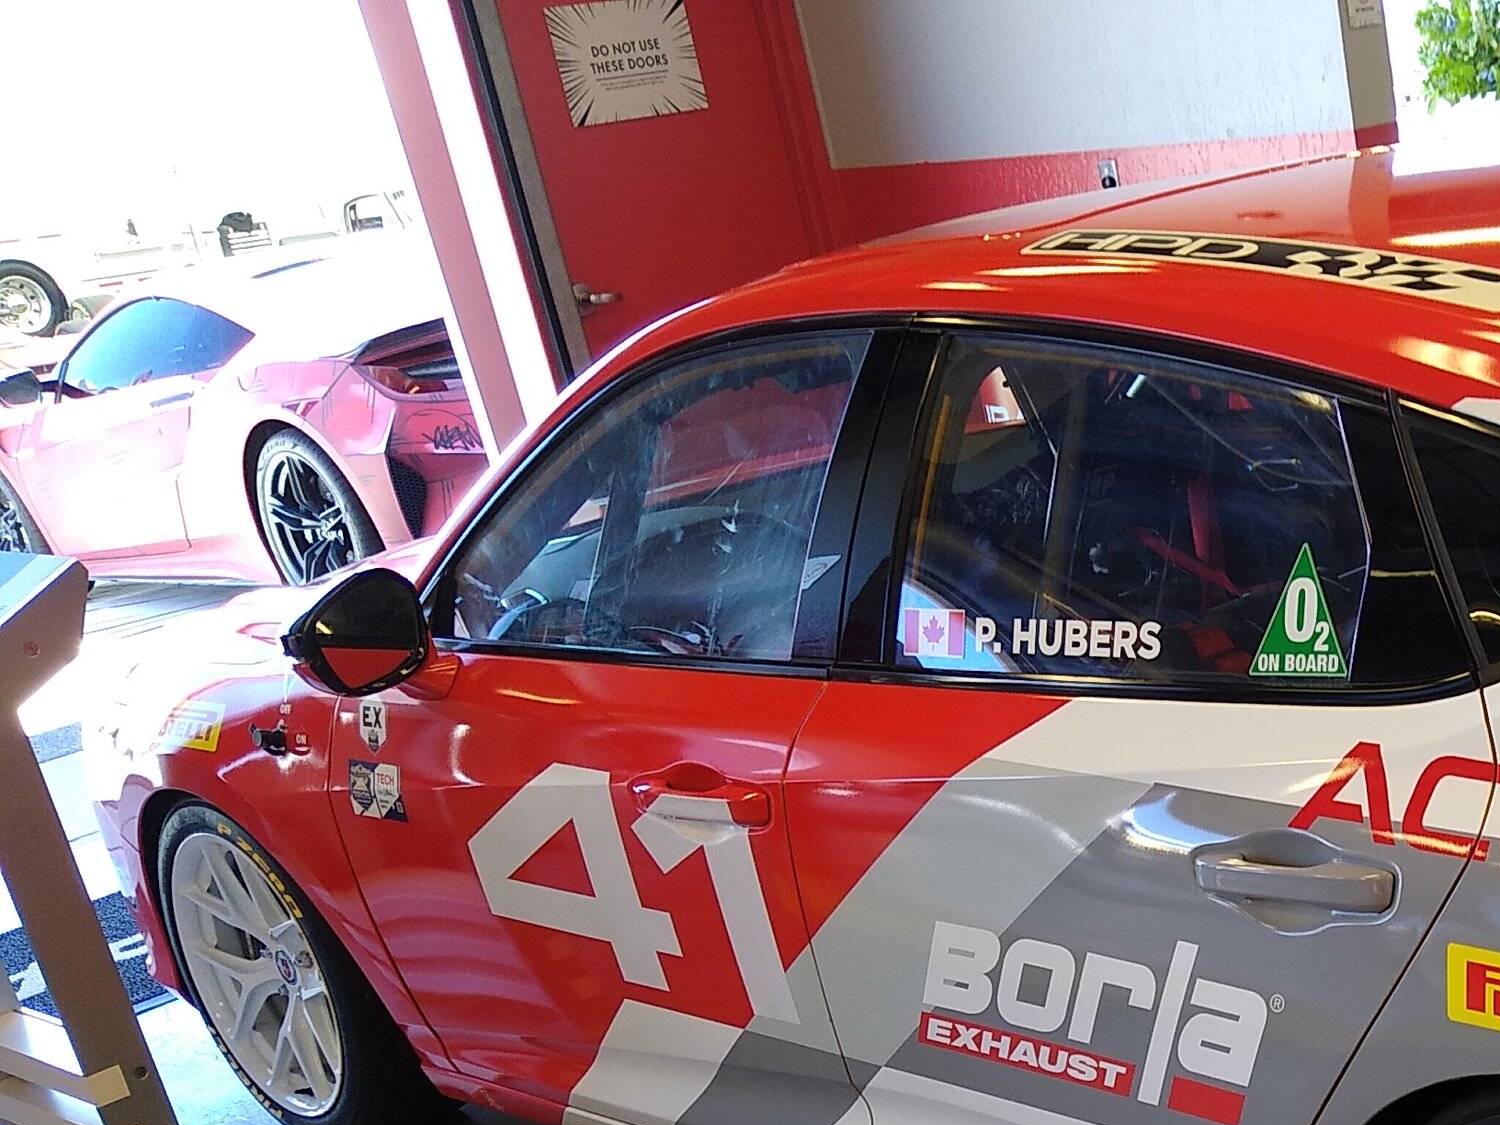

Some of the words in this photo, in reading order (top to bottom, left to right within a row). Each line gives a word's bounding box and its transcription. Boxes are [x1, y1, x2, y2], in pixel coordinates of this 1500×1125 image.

[590, 45, 610, 58] DO
[612, 40, 637, 56] NOT
[638, 37, 661, 52] USE
[590, 59, 626, 75] THESE
[627, 54, 669, 71] DOORS
[1040, 232, 1260, 260] HPD
[974, 616, 1001, 655] P.
[1011, 617, 1163, 661] HUBERS
[1257, 654, 1281, 673] ON
[1283, 654, 1340, 674] BOARD
[362, 705, 383, 729] EX
[375, 772, 395, 786] TECH
[467, 762, 801, 1026] 41
[925, 1016, 1128, 1090] EXHAUST
